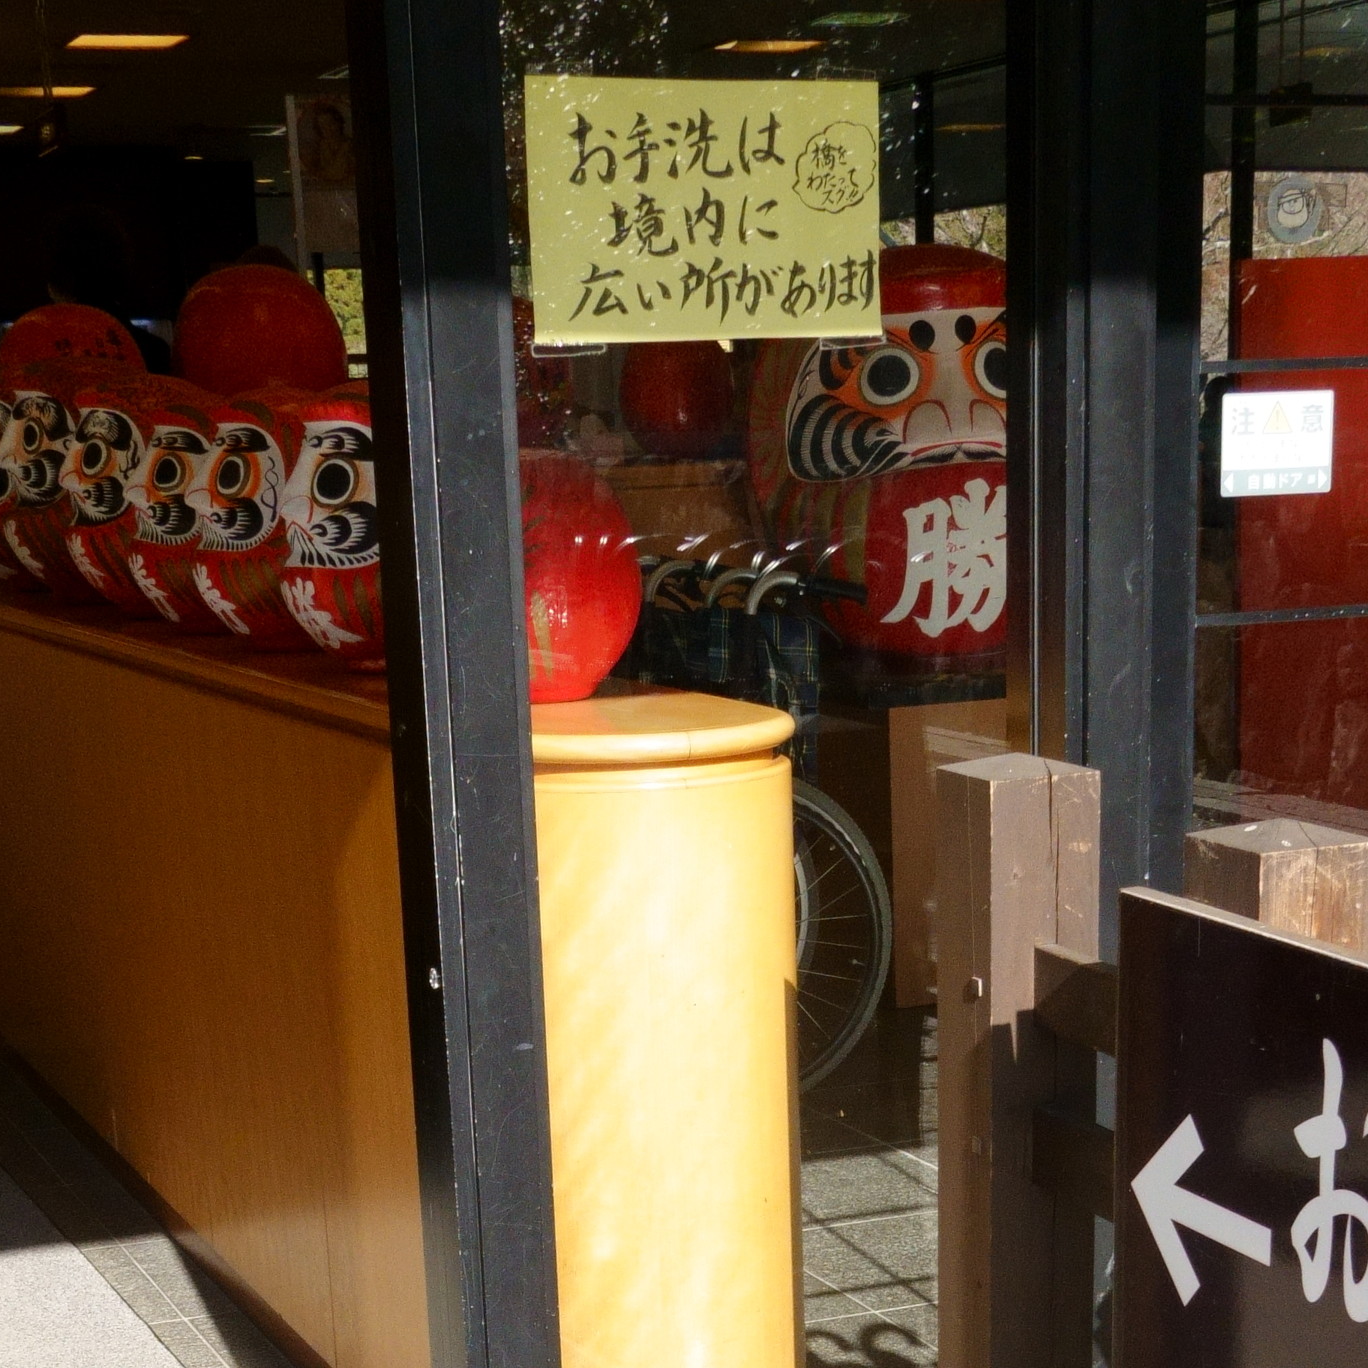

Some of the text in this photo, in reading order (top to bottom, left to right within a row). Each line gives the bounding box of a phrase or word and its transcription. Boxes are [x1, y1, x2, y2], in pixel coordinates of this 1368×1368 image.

[568, 108, 786, 186] お手洗は
[806, 167, 860, 192] わたって
[811, 138, 847, 172] 橋を
[606, 186, 780, 258] 境内に
[568, 248, 878, 327] 広い所があります
[879, 477, 1007, 638] 勝
